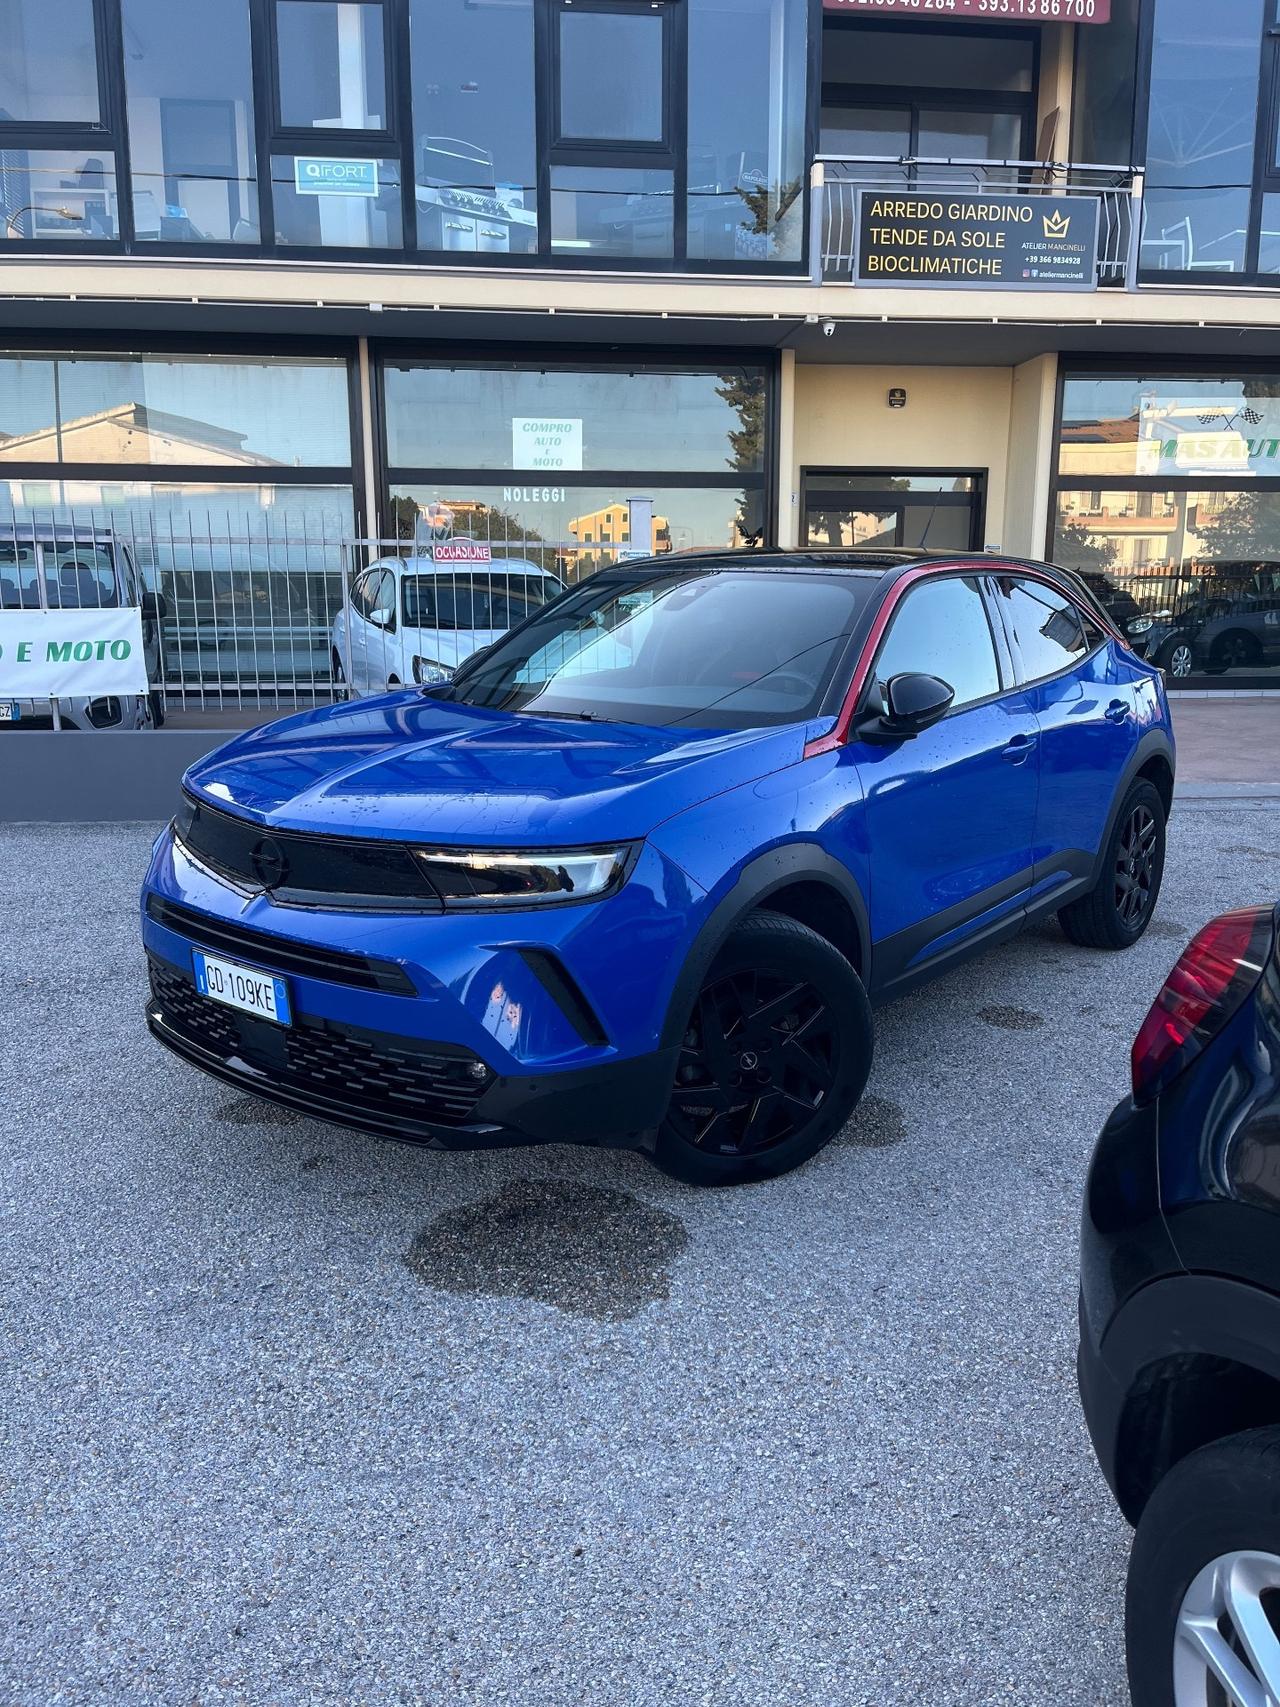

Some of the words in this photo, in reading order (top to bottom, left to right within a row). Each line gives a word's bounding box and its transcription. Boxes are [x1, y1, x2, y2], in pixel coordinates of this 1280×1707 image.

[870, 200, 943, 219] ARREDO
[948, 203, 1033, 223] GIARDINO
[870, 228, 928, 246] TENDE
[933, 230, 957, 247] DA
[961, 231, 1006, 248] SOLE
[1021, 242, 1047, 250] ATELIER
[1048, 243, 1086, 252] MANCINELLI
[868, 255, 1002, 275] BIOCLIMATICHE
[1025, 255, 1038, 263] +39
[522, 422, 572, 432] COMPRO
[534, 437, 562, 446] AUTO
[532, 457, 564, 467] MOTO
[503, 487, 566, 502] NOLEGGI
[435, 546, 490, 559] OCCASIONE
[16, 641, 33, 663] E
[46, 639, 131, 662] MOTO
[228, 972, 275, 1012] 109KE
